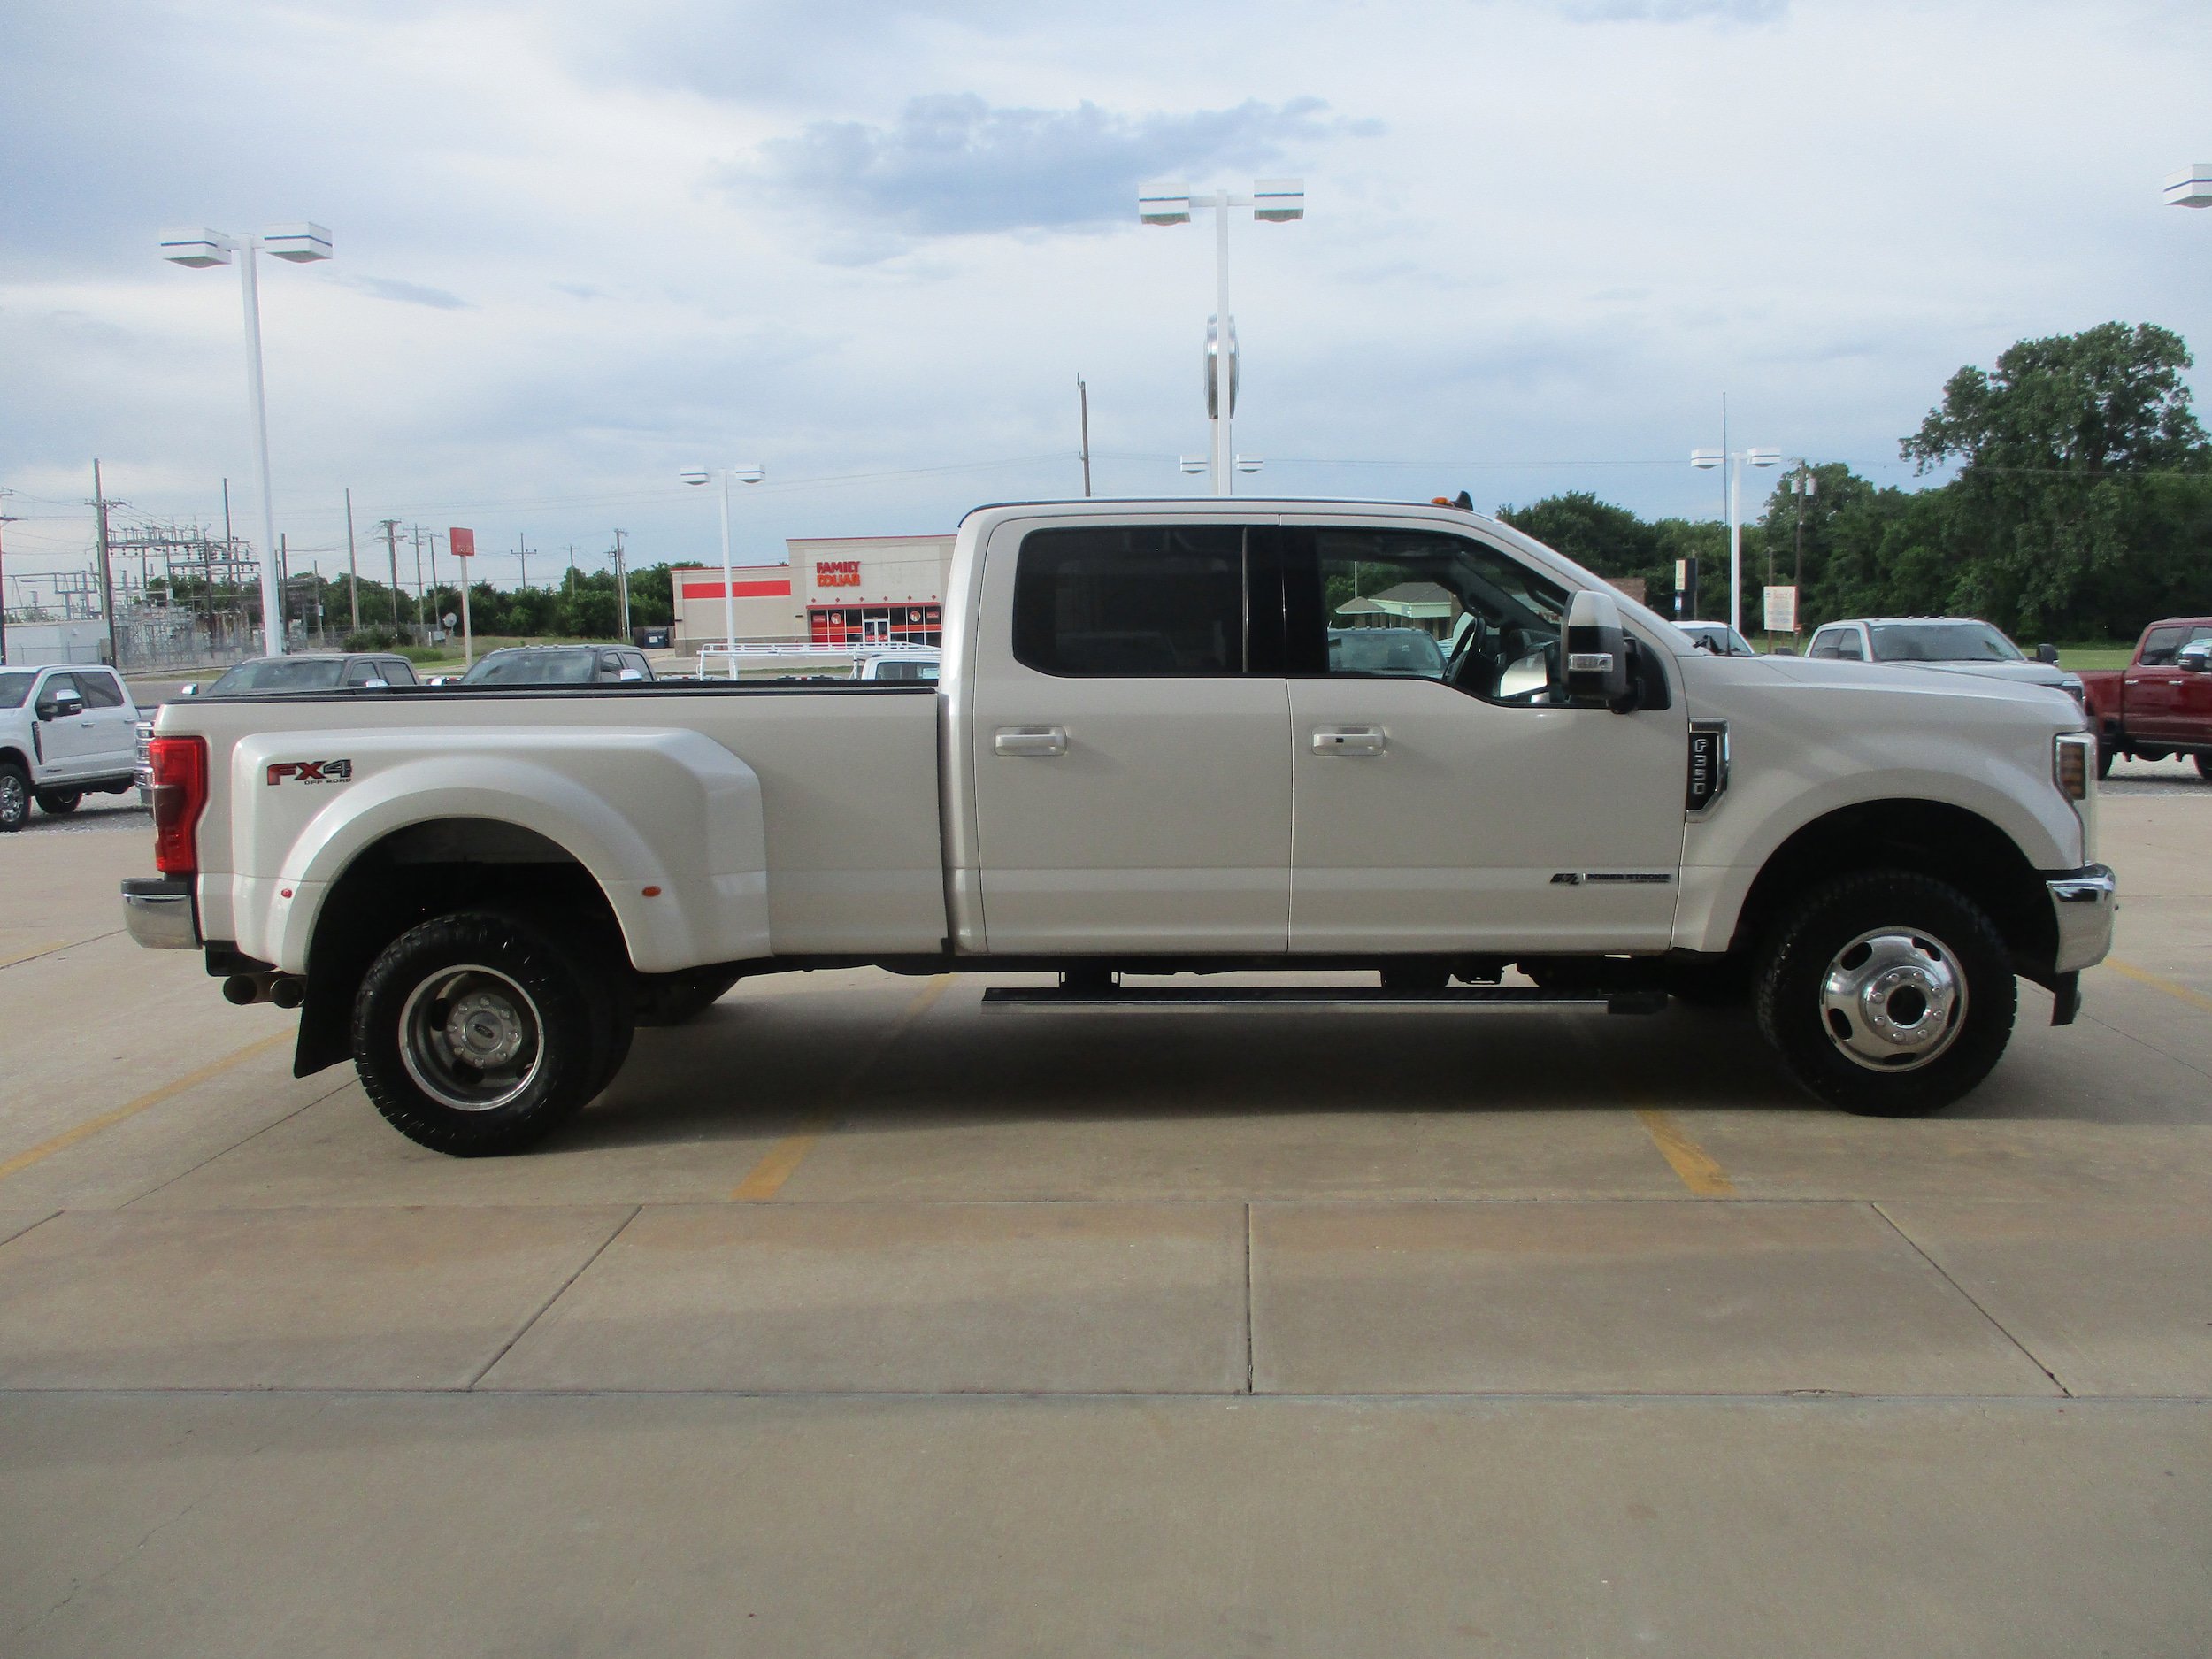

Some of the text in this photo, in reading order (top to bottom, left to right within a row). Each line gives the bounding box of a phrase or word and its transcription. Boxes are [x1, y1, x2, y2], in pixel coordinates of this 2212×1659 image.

[816, 561, 861, 573] FAMILY
[817, 573, 861, 587] DOLLAR
[267, 759, 351, 786] FX4
